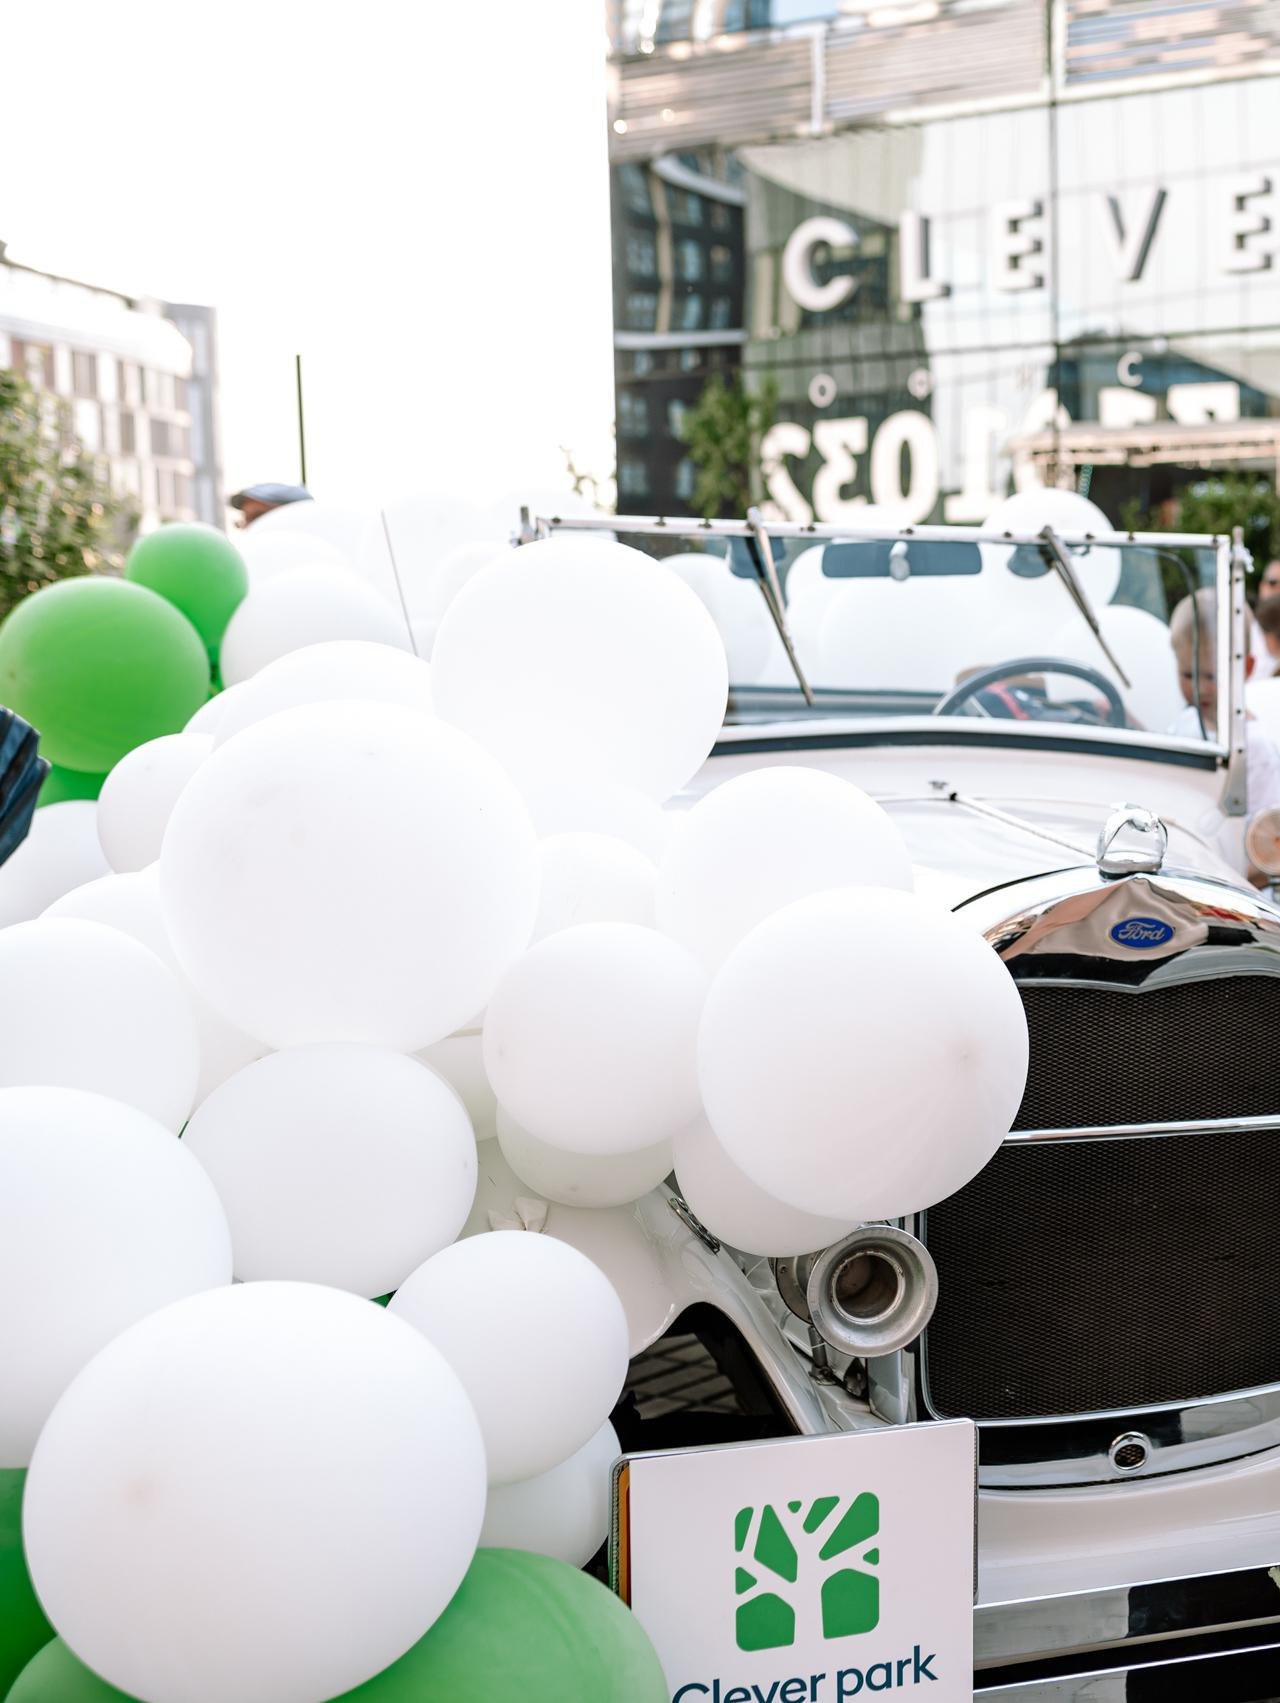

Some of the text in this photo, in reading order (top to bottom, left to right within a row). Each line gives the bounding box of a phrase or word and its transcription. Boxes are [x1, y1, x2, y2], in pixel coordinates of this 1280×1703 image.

[1119, 920, 1165, 941] Ford
[672, 1645, 939, 1703] Clever park
